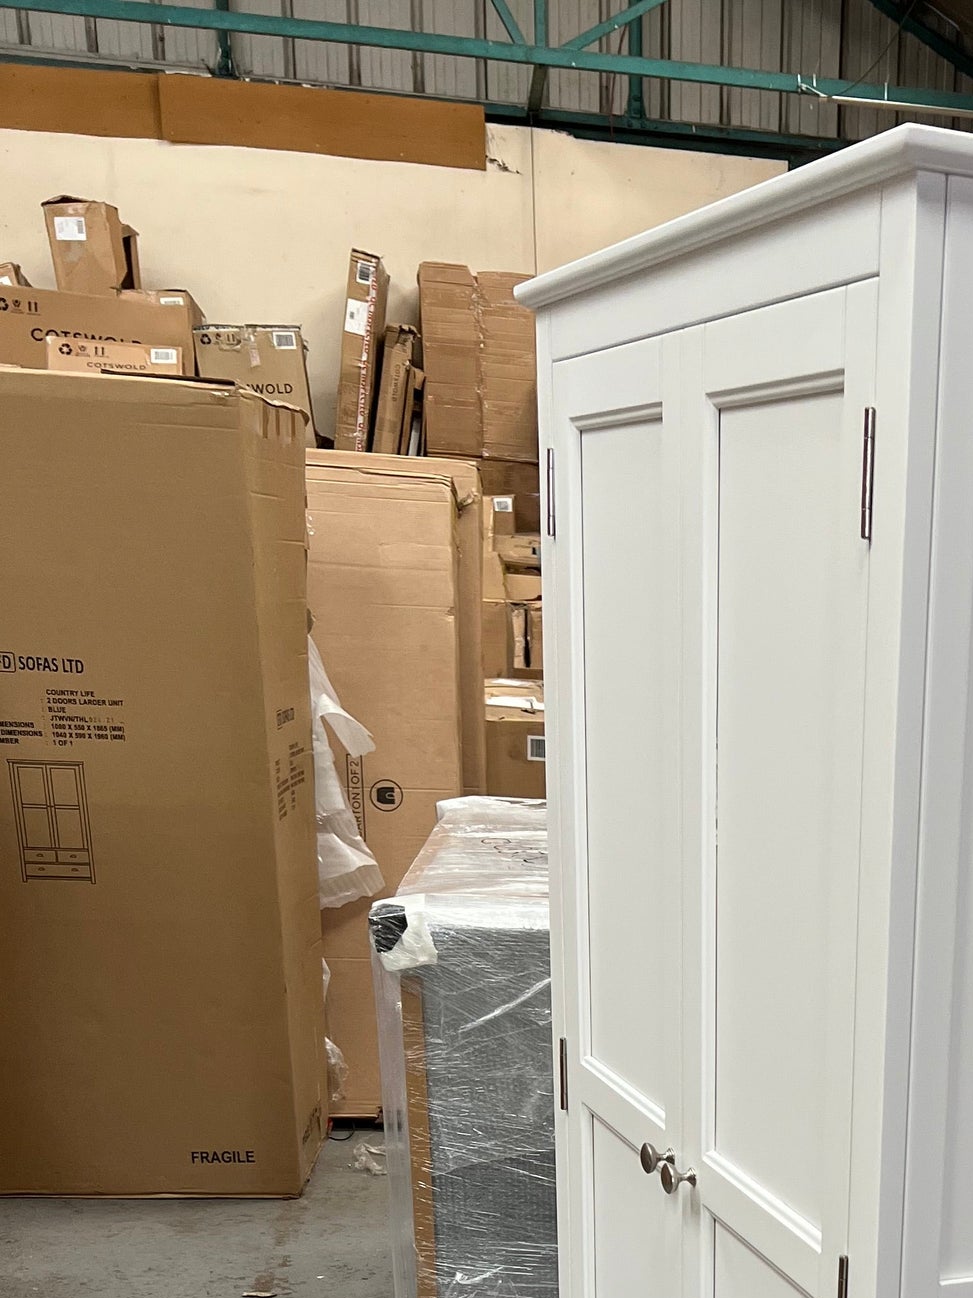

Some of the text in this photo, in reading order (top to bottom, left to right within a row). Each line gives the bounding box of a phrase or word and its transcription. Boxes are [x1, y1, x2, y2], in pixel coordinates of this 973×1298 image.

[86, 361, 147, 371] COTSWOLD
[246, 383, 293, 394] WOLD
[18, 656, 59, 673] SOFAS
[62, 658, 85, 674] LTD
[46, 689, 79, 697] COUNTRY
[1, 729, 43, 737] DIMENSIONS
[350, 769, 360, 785] OF
[190, 1150, 256, 1164] FRAGILE
